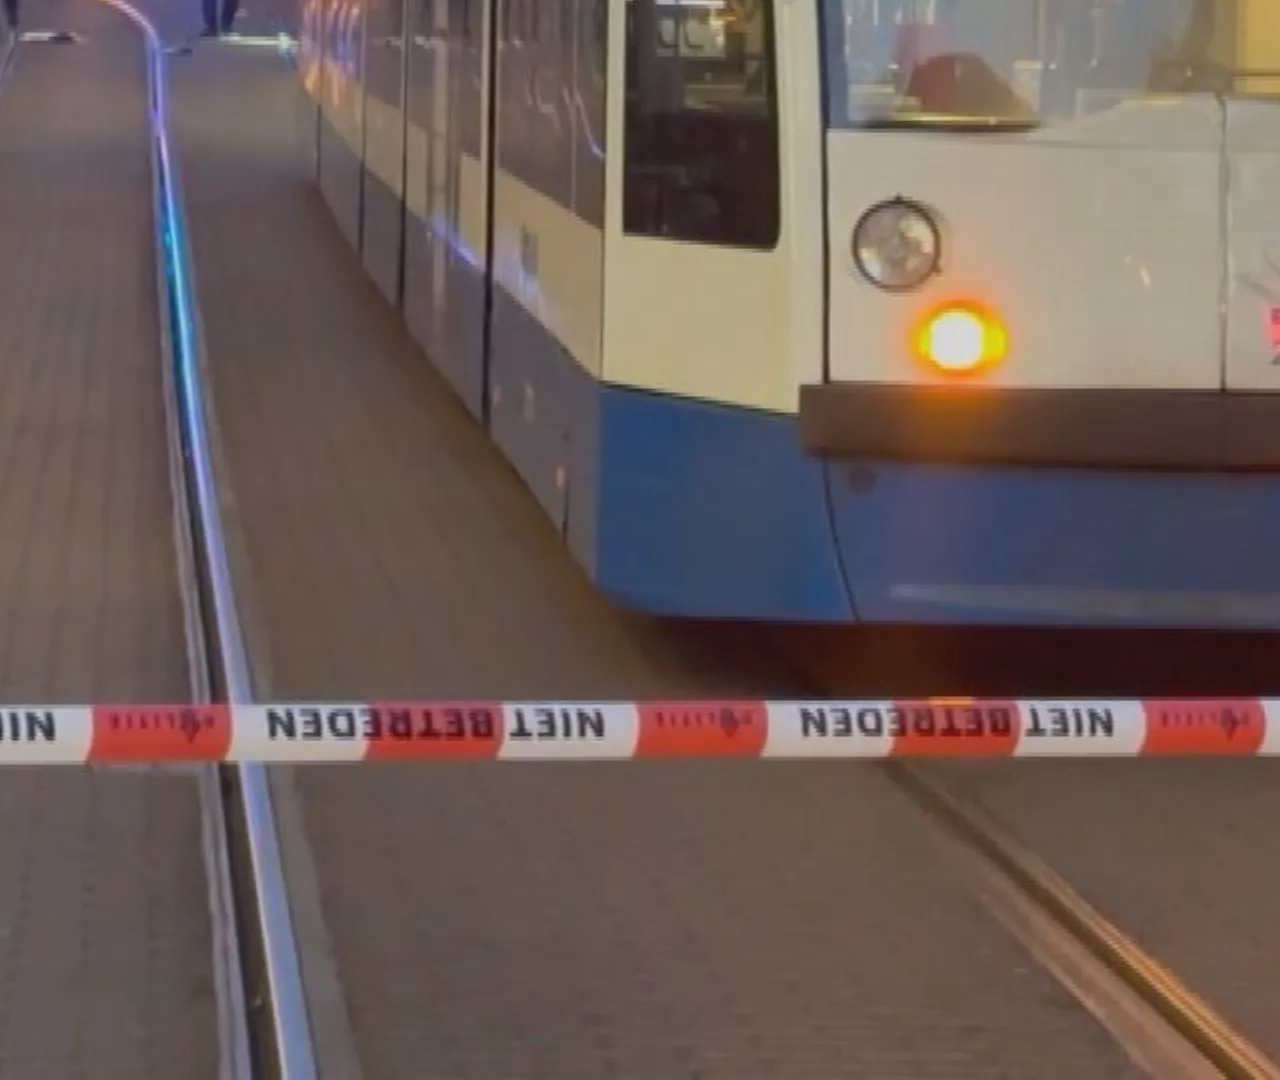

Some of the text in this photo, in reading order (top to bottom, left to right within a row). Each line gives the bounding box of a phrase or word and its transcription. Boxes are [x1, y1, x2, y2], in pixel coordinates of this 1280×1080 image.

[266, 707, 494, 740] BETREDEN
[509, 708, 605, 739] NIET
[799, 706, 1006, 738] BETREDEN
[1025, 706, 1114, 737] NIET
